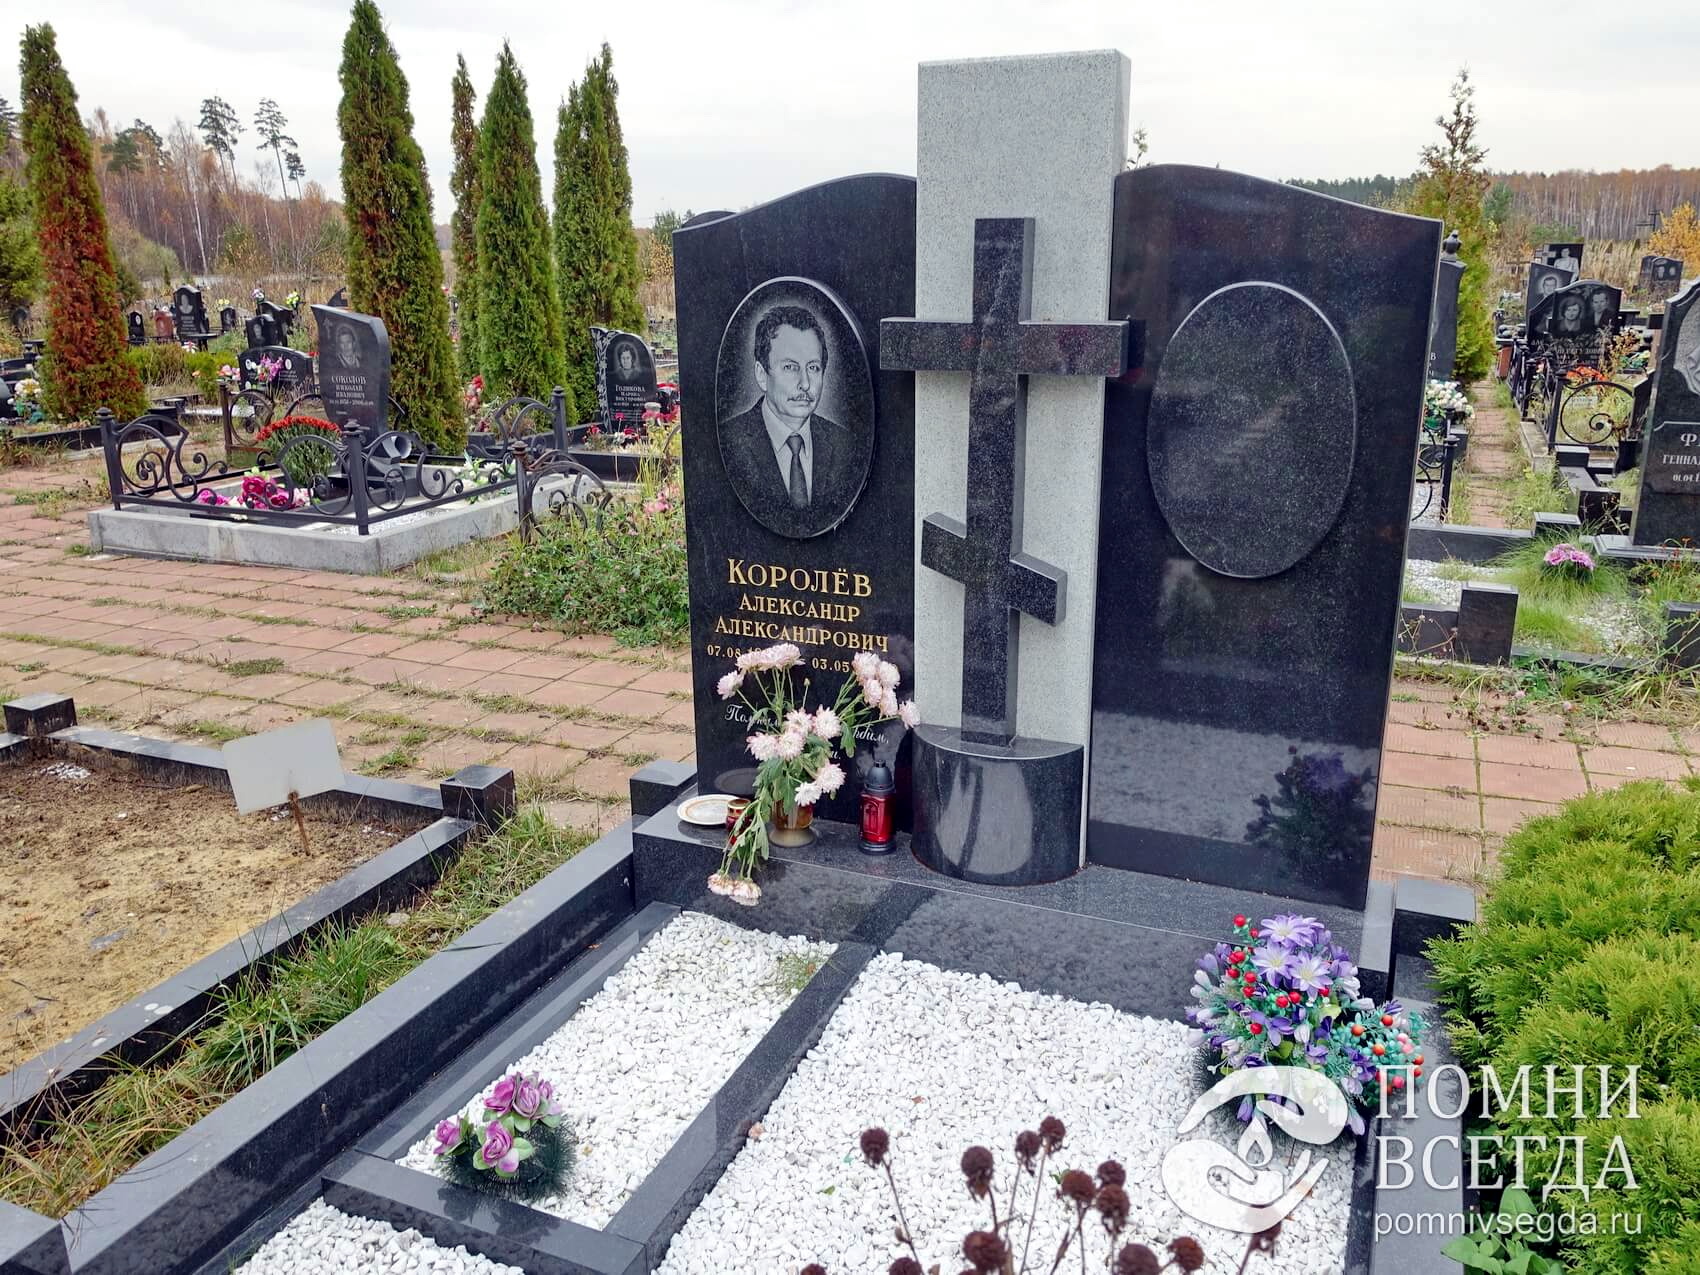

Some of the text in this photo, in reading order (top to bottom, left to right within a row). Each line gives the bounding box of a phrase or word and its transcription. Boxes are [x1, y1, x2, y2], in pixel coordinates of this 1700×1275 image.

[727, 558, 872, 598] КОРОЛЁВ
[738, 593, 861, 622] АЛЕКСАНДР
[714, 616, 888, 652] АЛЕКСАНДРОВИЧ
